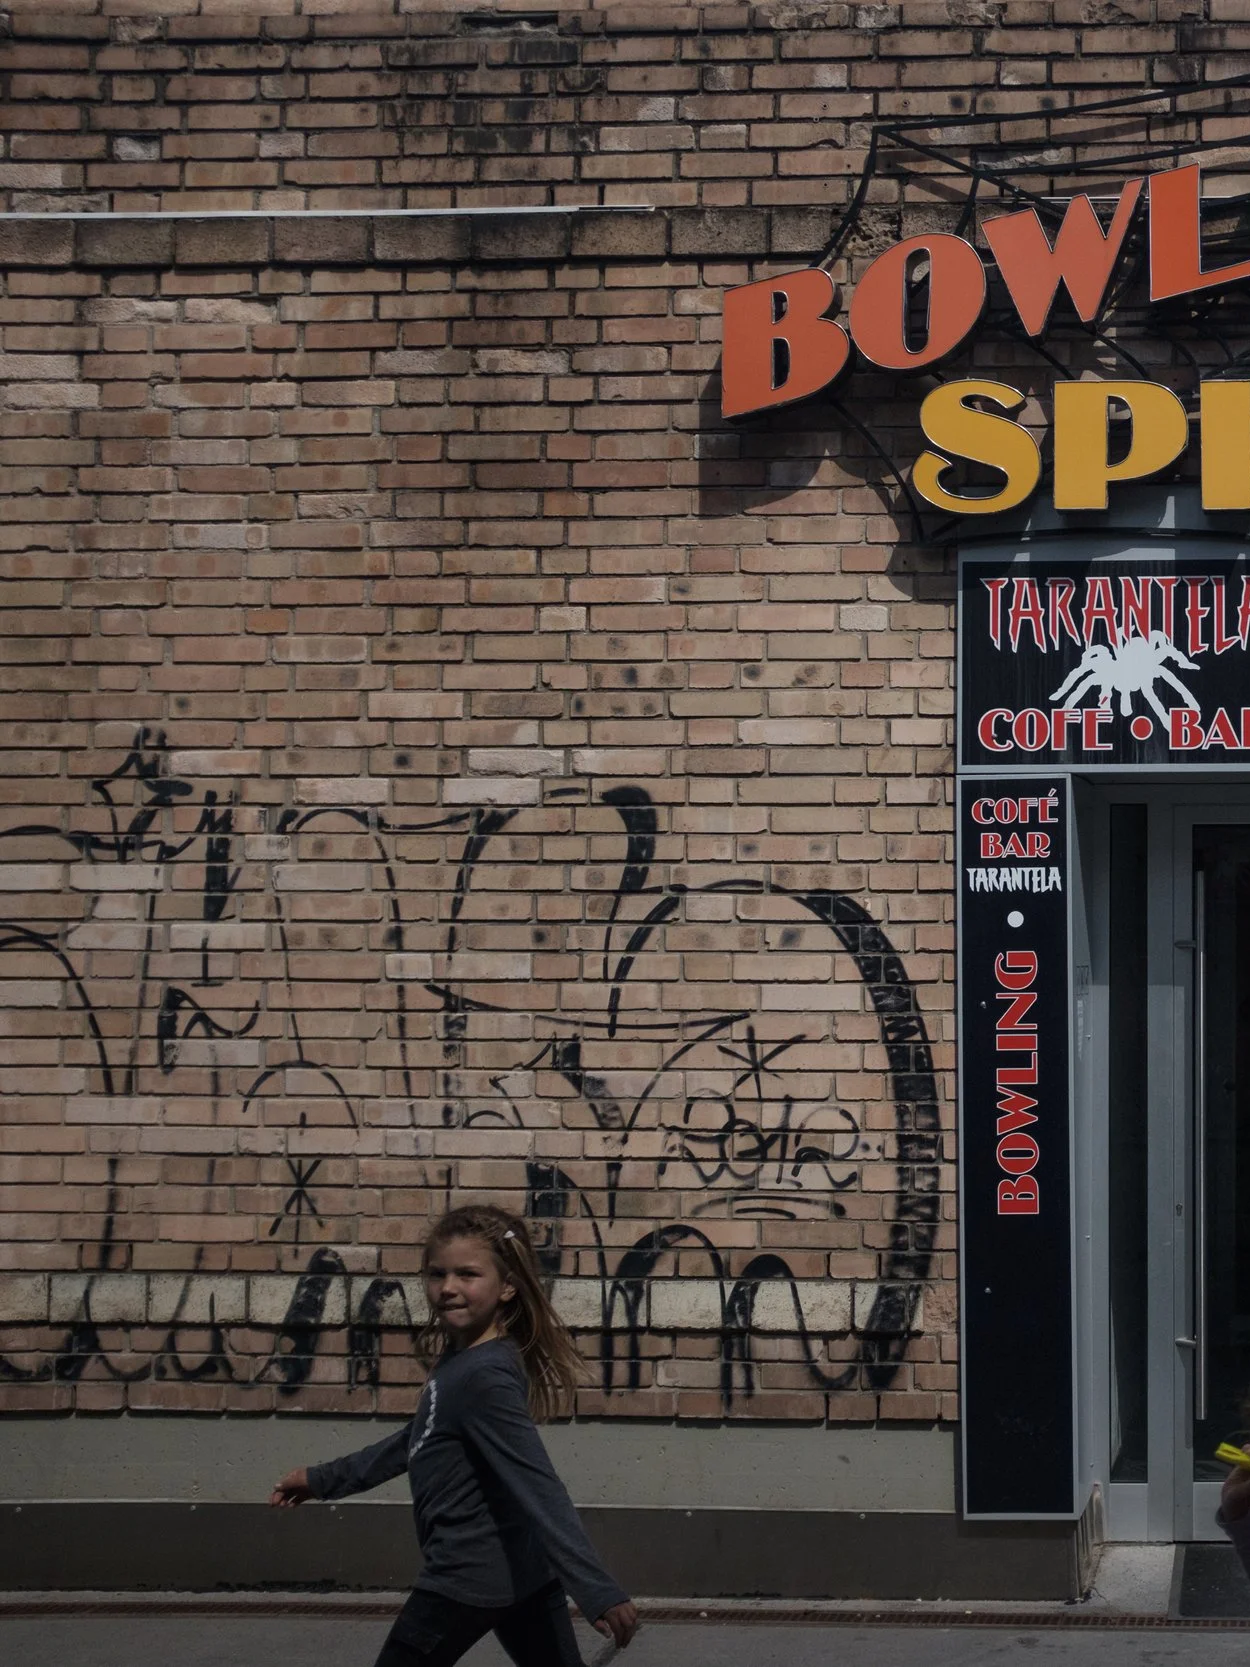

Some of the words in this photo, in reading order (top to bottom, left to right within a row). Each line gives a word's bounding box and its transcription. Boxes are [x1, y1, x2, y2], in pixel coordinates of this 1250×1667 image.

[970, 787, 1060, 825] COFÉ
[980, 831, 1051, 859] BAR
[965, 866, 1063, 894] TARANTELA
[994, 950, 1041, 1216] BOWLING
